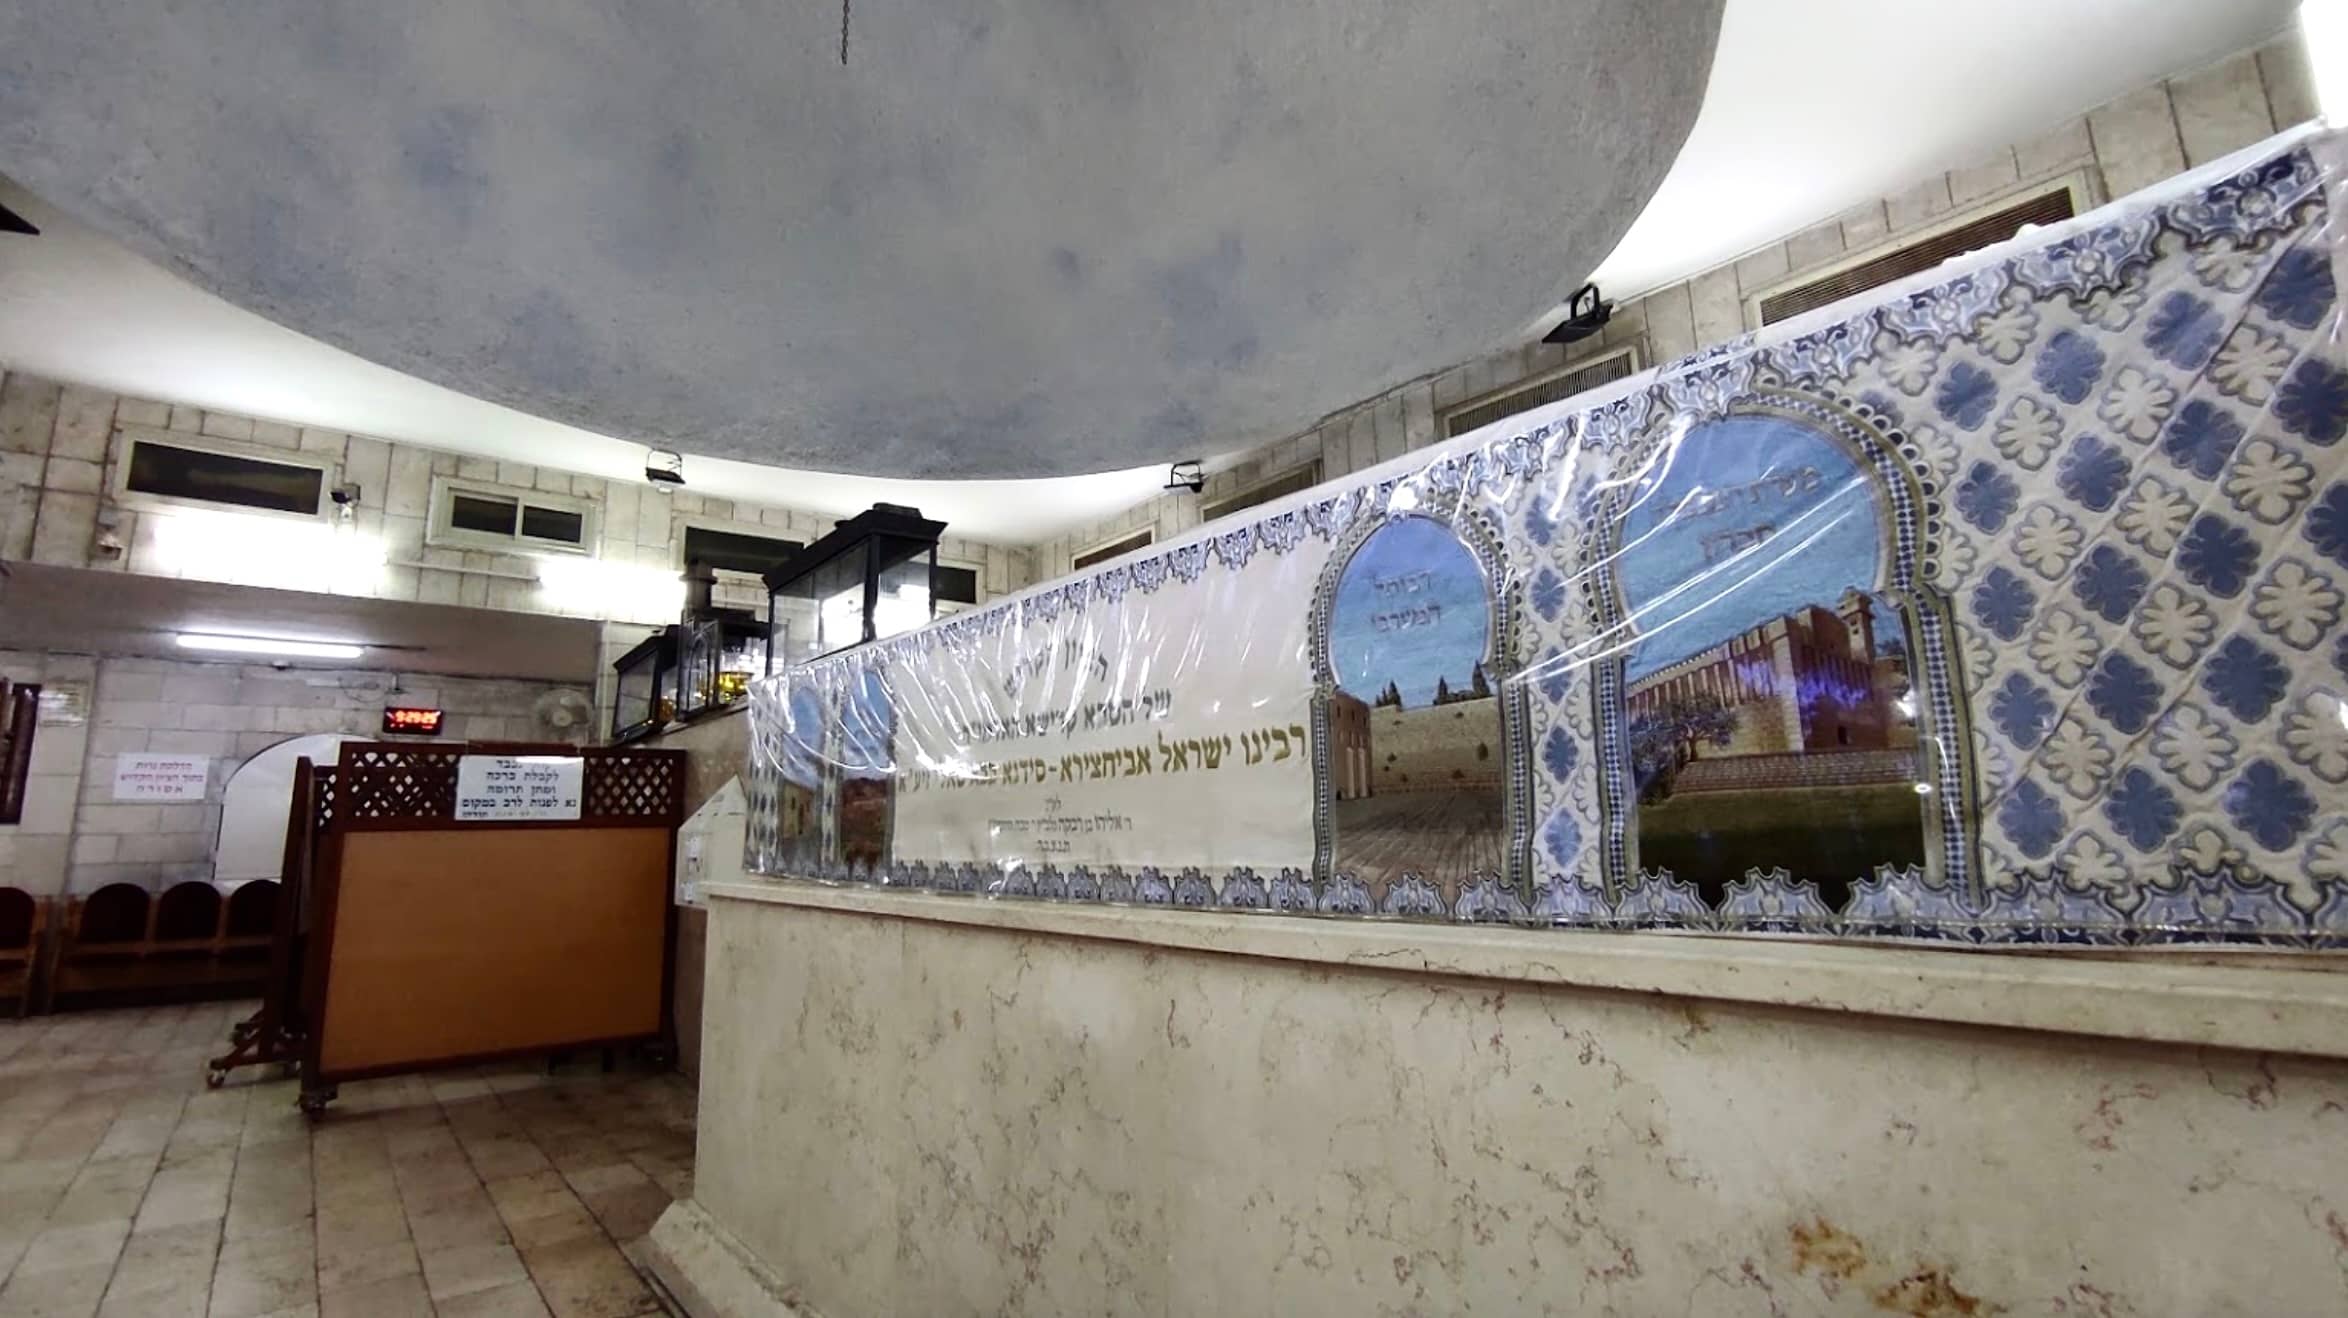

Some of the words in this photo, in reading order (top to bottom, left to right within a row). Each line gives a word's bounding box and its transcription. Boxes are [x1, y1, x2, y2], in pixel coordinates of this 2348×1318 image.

[1158, 728, 1232, 773] ישראל
[1240, 722, 1306, 766] רבינו
[486, 771, 516, 781] ברכה
[524, 768, 560, 784] לקבלת
[486, 785, 524, 795] תרומה
[530, 785, 557, 797] ומתן
[462, 798, 497, 811] במקום
[529, 795, 560, 808] לפנות
[564, 799, 577, 808] נא
